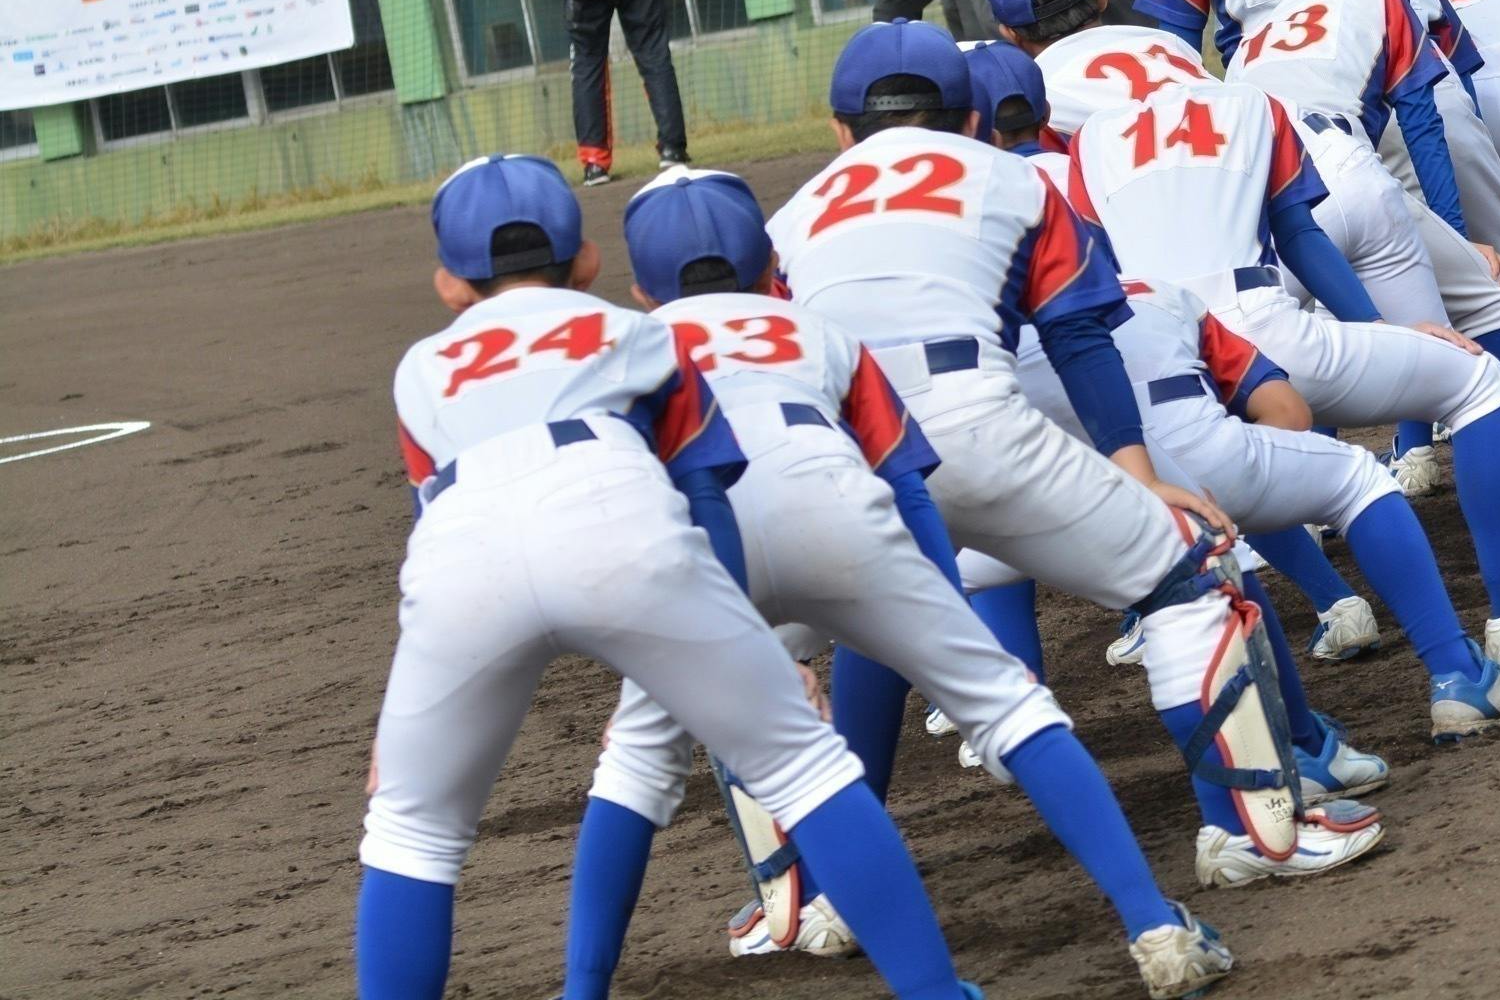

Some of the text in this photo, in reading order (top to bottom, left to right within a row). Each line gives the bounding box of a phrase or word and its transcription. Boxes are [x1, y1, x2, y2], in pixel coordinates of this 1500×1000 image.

[1241, 3, 1328, 69] 13
[1121, 98, 1229, 169] 14
[808, 152, 967, 240] 22
[437, 312, 616, 398] 24
